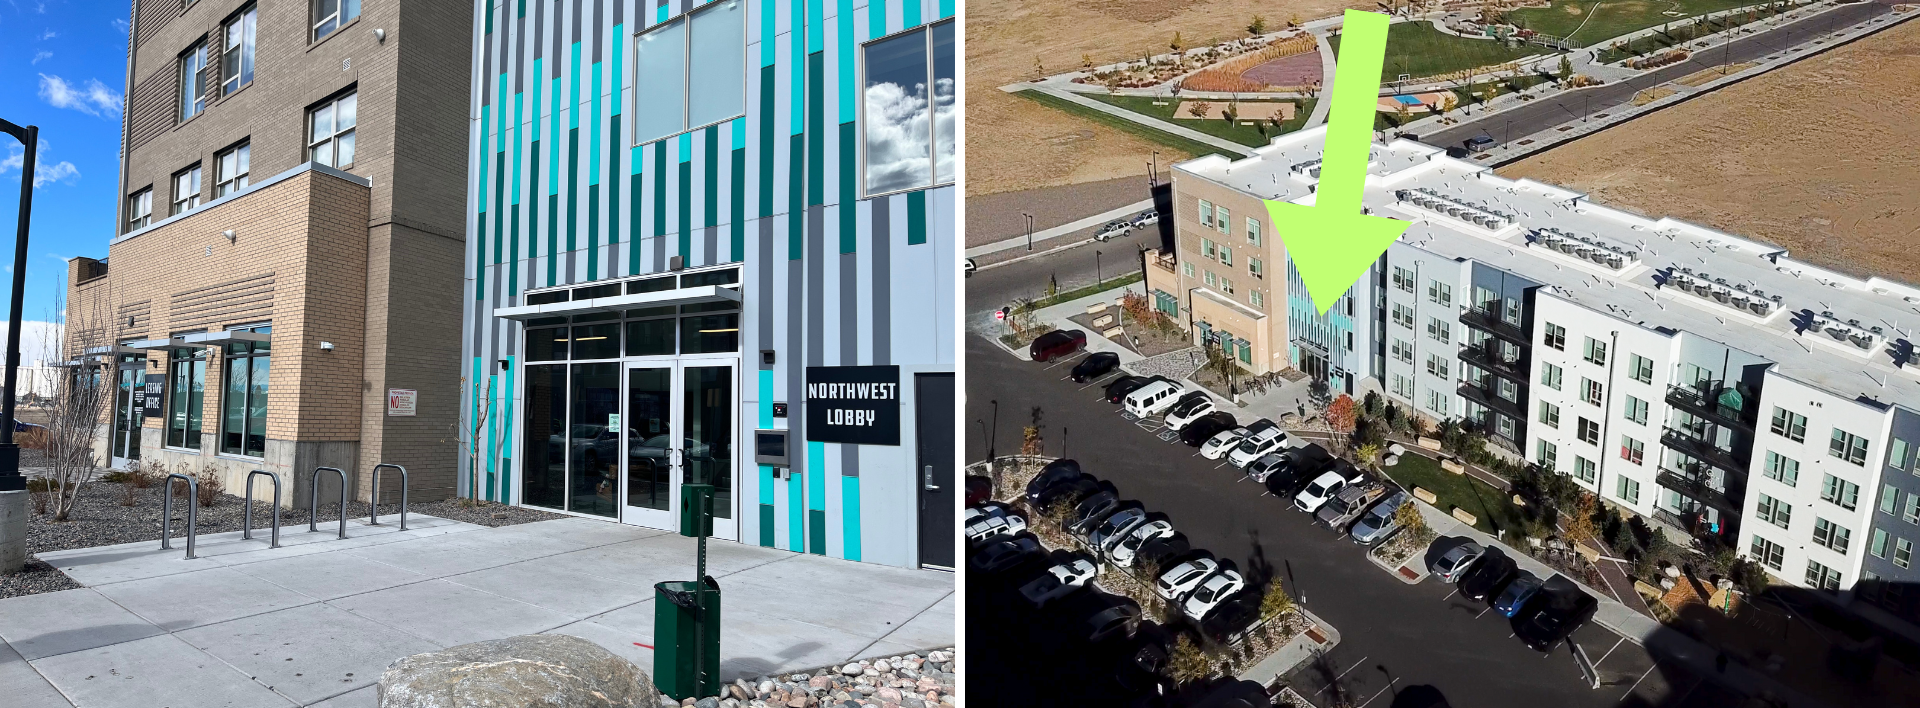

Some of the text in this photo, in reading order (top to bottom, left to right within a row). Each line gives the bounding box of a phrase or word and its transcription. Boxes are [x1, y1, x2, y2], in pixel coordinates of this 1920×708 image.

[808, 383, 896, 399] NORTHWEST
[146, 397, 159, 408] OFFICE
[391, 396, 399, 408] NO
[827, 409, 875, 426] LOBBY
